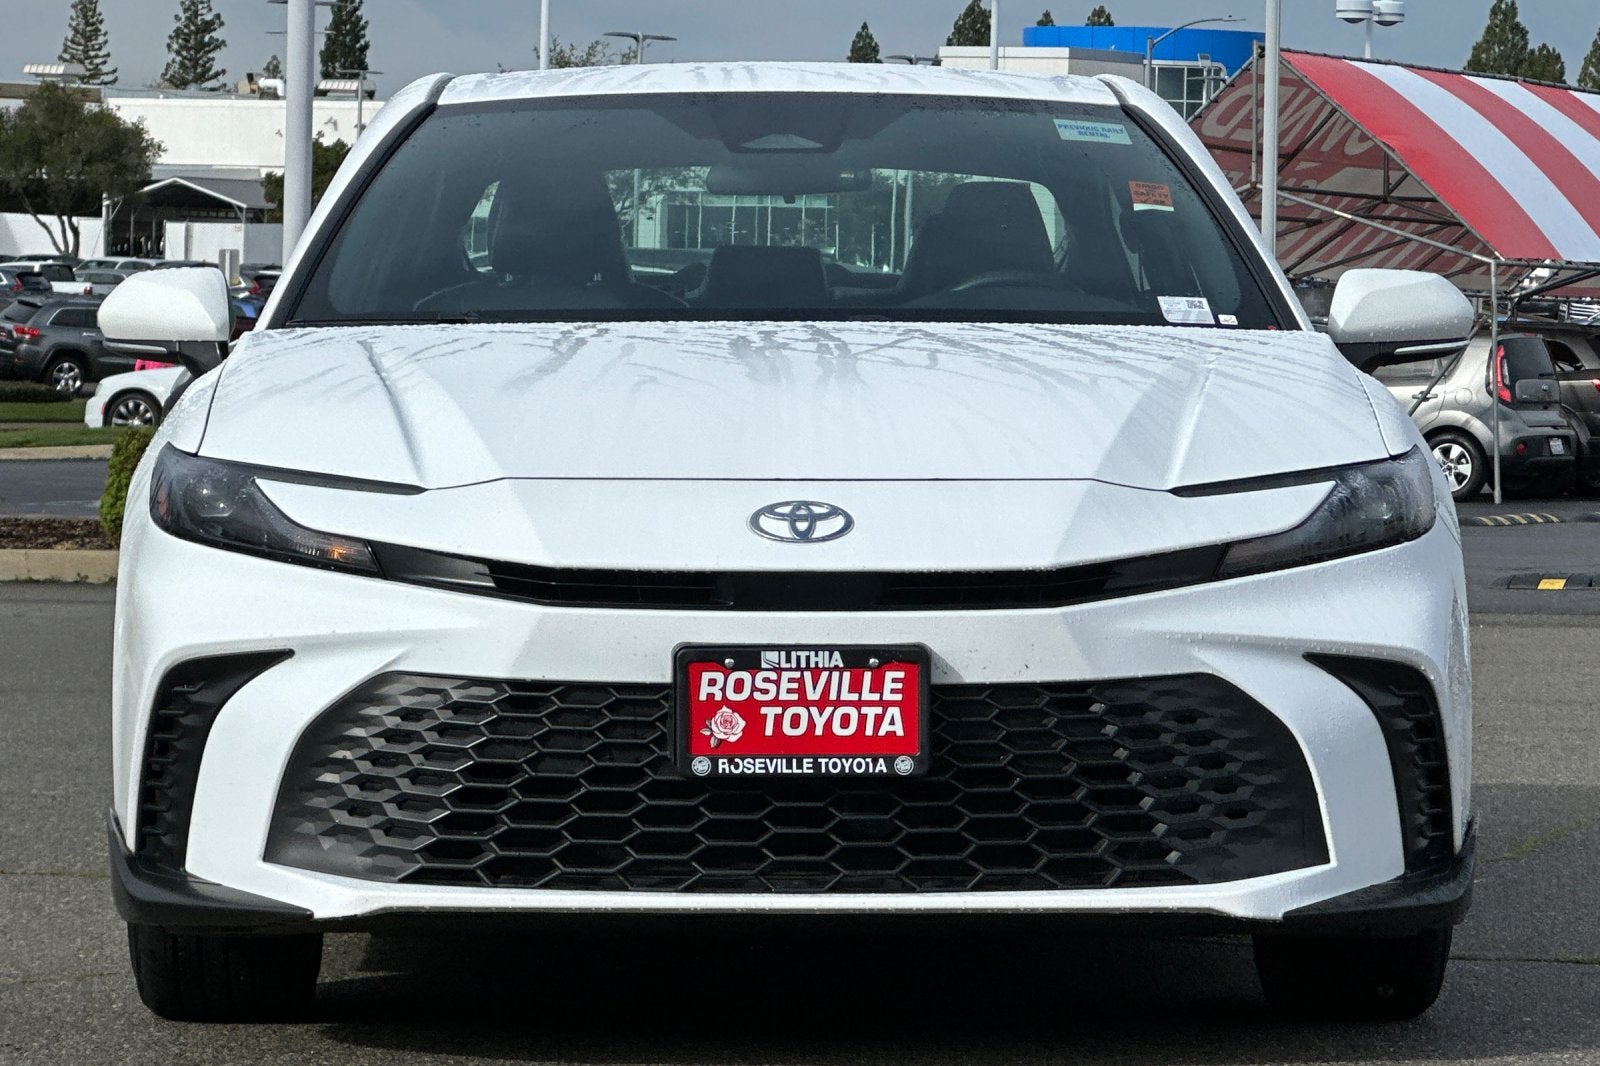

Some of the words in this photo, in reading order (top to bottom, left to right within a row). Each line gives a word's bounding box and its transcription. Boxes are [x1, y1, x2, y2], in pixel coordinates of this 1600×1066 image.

[1057, 123, 1097, 131] PREVIOUS
[779, 651, 844, 668] LITHIA
[699, 671, 905, 701] ROSEVILLE
[760, 706, 905, 736] TOYOTA
[718, 758, 813, 773] ROSEVILLE
[818, 758, 887, 773] TOYOTA
